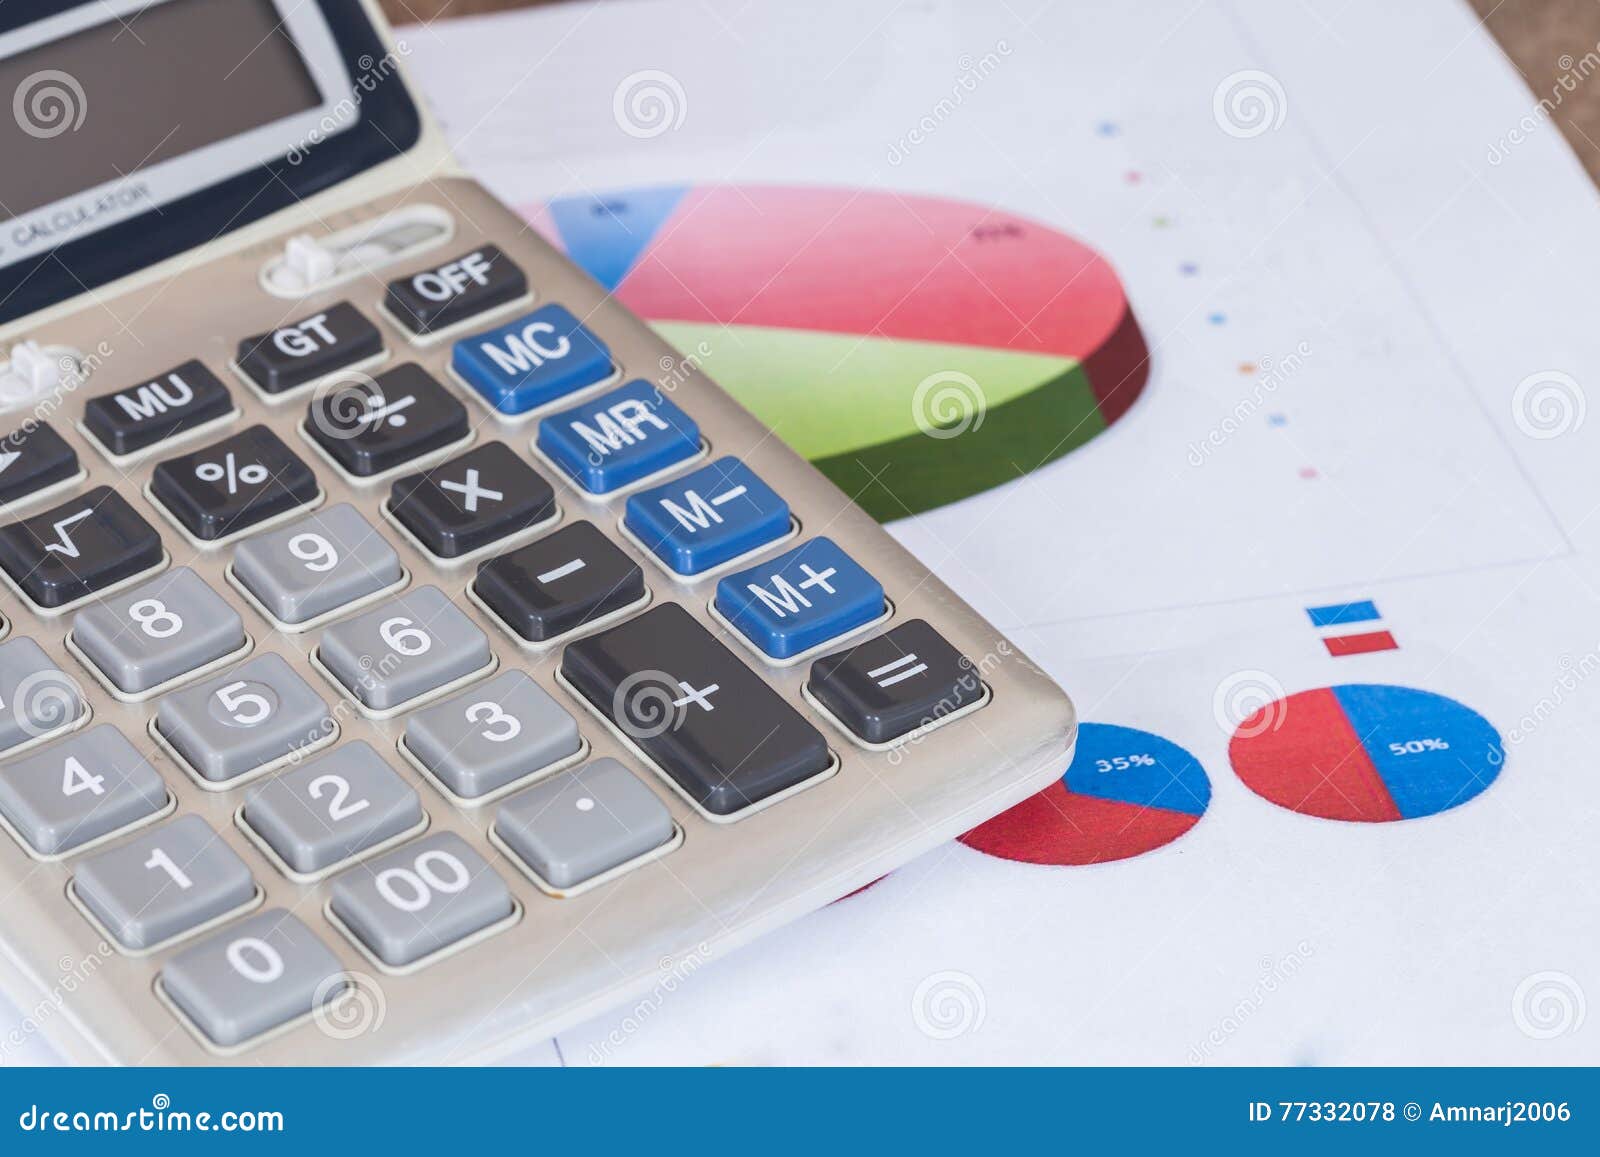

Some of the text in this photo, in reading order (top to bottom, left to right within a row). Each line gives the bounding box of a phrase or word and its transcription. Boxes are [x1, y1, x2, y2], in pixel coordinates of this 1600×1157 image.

[12, 182, 150, 247] CALCULATOR
[413, 253, 497, 301] OFF
[273, 314, 338, 357] GT
[481, 321, 571, 375] MC
[114, 374, 193, 421] MU
[570, 399, 669, 455] MR
[195, 452, 268, 494] %
[288, 533, 339, 572] 9
[747, 563, 837, 617] M+
[128, 599, 183, 638] 8
[379, 617, 432, 656] 6
[215, 680, 271, 727] 5
[465, 701, 521, 742] 3
[1095, 753, 1155, 773] 35%
[1388, 737, 1449, 756] 50%
[61, 756, 105, 798] 4
[307, 774, 370, 821] 2
[144, 848, 193, 889] 1
[375, 850, 470, 912] 00
[226, 938, 285, 983] 0
